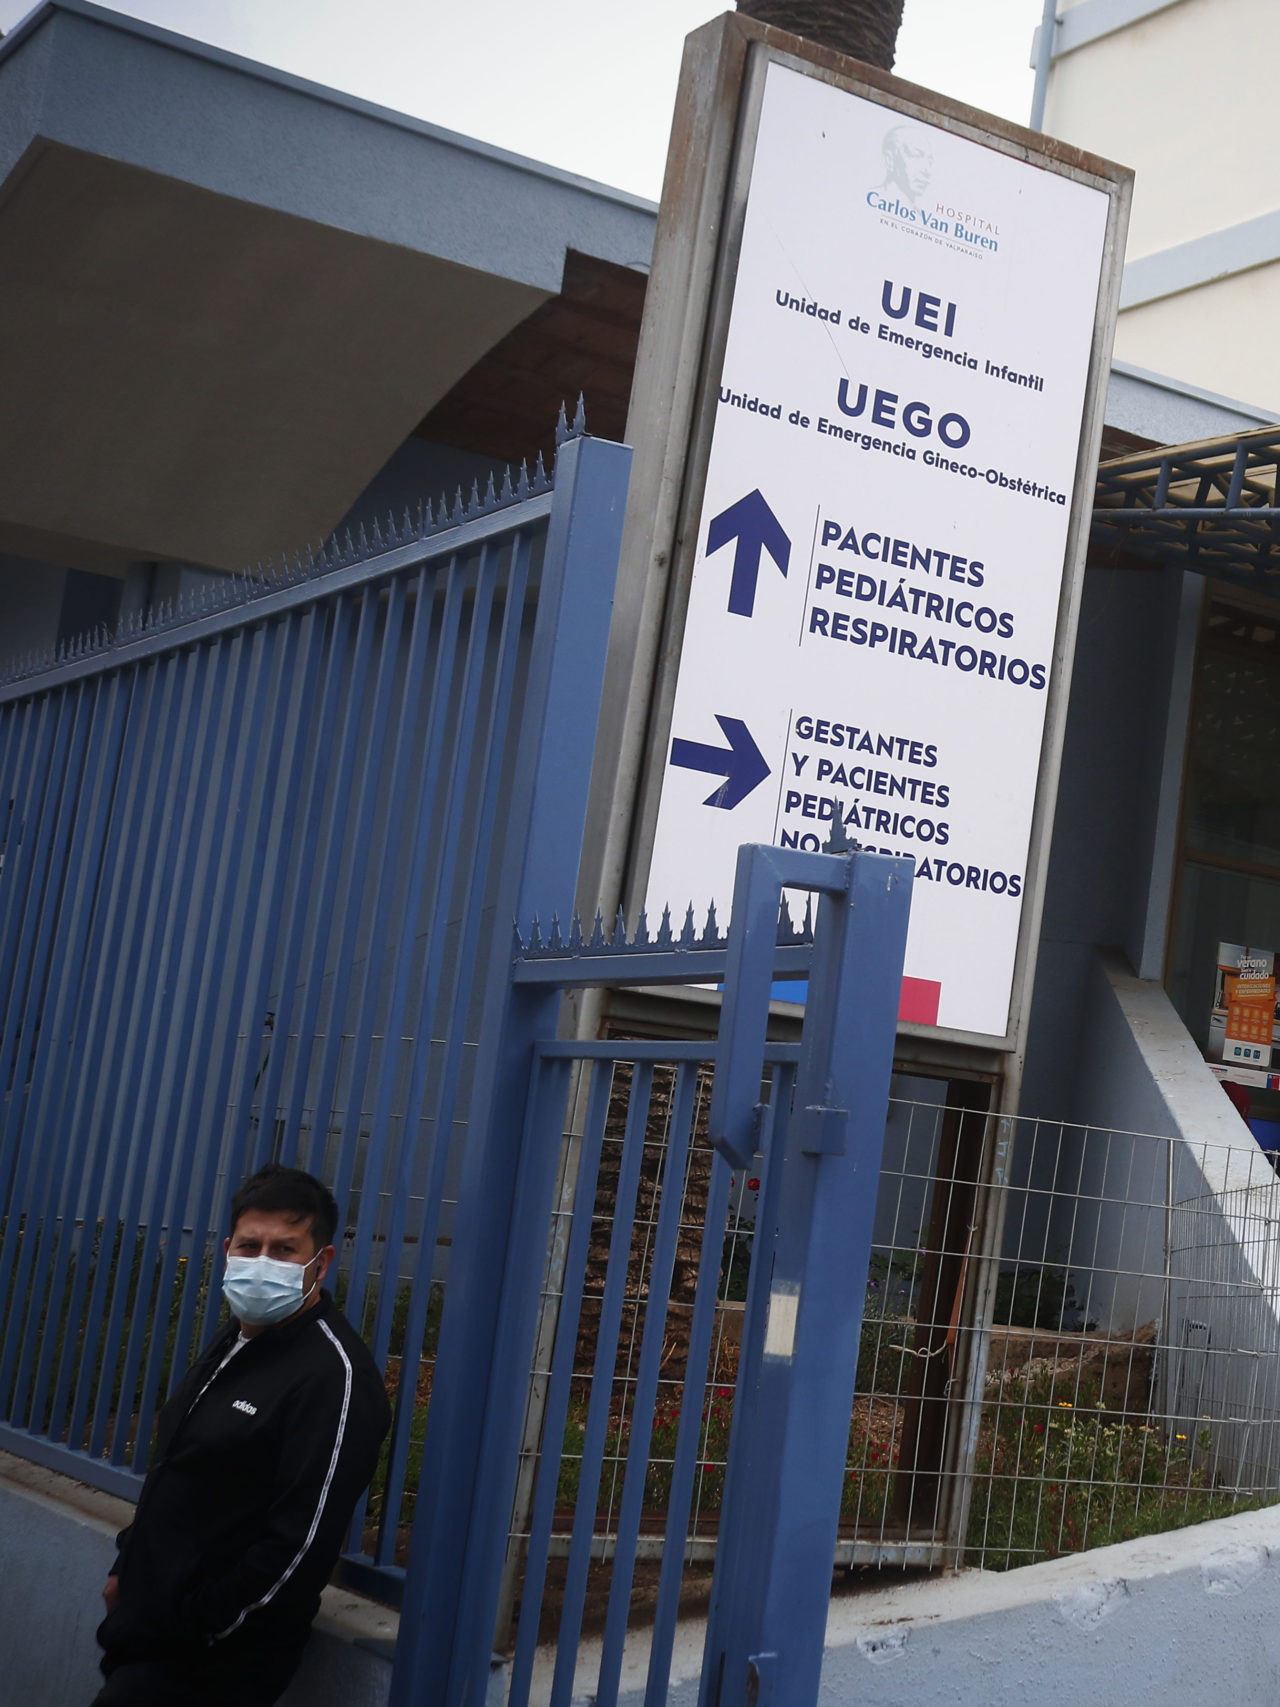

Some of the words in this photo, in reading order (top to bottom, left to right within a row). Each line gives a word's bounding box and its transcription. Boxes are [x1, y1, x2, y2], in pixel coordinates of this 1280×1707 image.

[866, 191, 917, 221] Carlos
[921, 210, 949, 233] Van
[954, 223, 999, 252] Buren
[936, 203, 1000, 235] HOSPITAL
[882, 280, 957, 337] UEI
[775, 289, 842, 325] Unidad
[848, 314, 871, 334] de
[877, 324, 978, 370] Emergencia
[985, 360, 1044, 392] Infantil
[837, 377, 971, 449] UEGO
[718, 386, 782, 420] Unidad
[788, 410, 811, 429] de
[817, 417, 917, 461] Emergencia
[922, 450, 1066, 506] Gineco-Obstétrica
[820, 519, 985, 588] PACIENTES
[815, 562, 1014, 639] PEDIÁTRICOS
[809, 606, 1047, 690] RESPIRATORIOS
[795, 715, 938, 767] GESTANTES
[792, 752, 809, 776] Y
[816, 758, 950, 808] PACIENTES
[780, 828, 820, 852] NO
[856, 842, 1022, 898] ATORIOS
[1237, 959, 1267, 968] verano
[1240, 970, 1269, 980] cuidado
[232, 1400, 257, 1415] adidas
